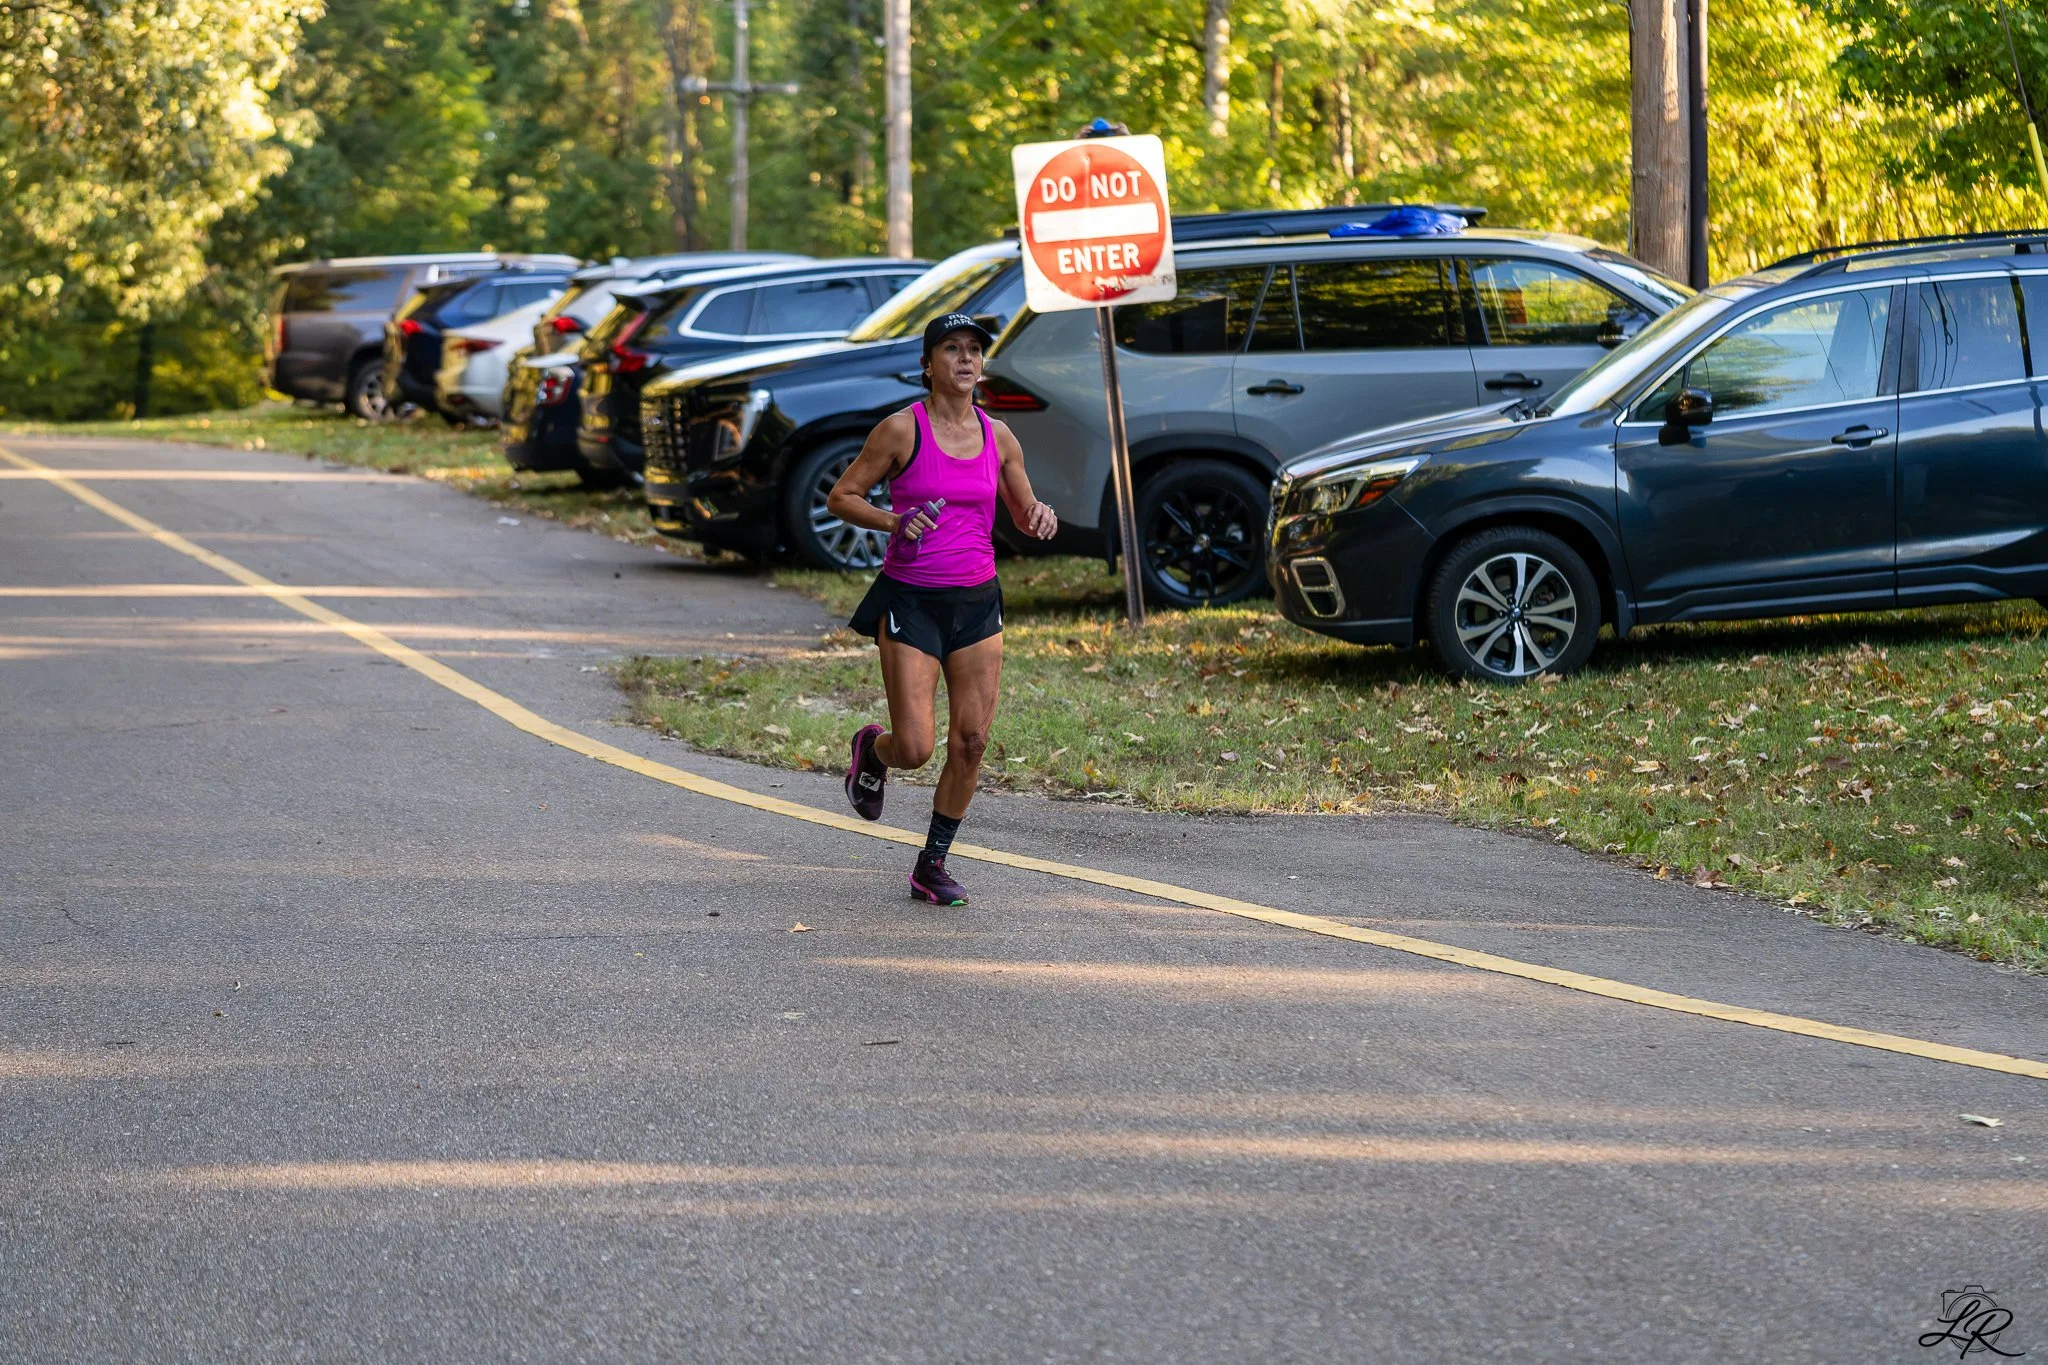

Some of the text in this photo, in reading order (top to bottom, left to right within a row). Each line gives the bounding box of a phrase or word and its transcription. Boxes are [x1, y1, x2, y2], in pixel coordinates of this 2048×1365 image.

[1040, 170, 1142, 204] DO NOT
[1057, 242, 1140, 275] ENTER
[944, 318, 976, 328] HAP
